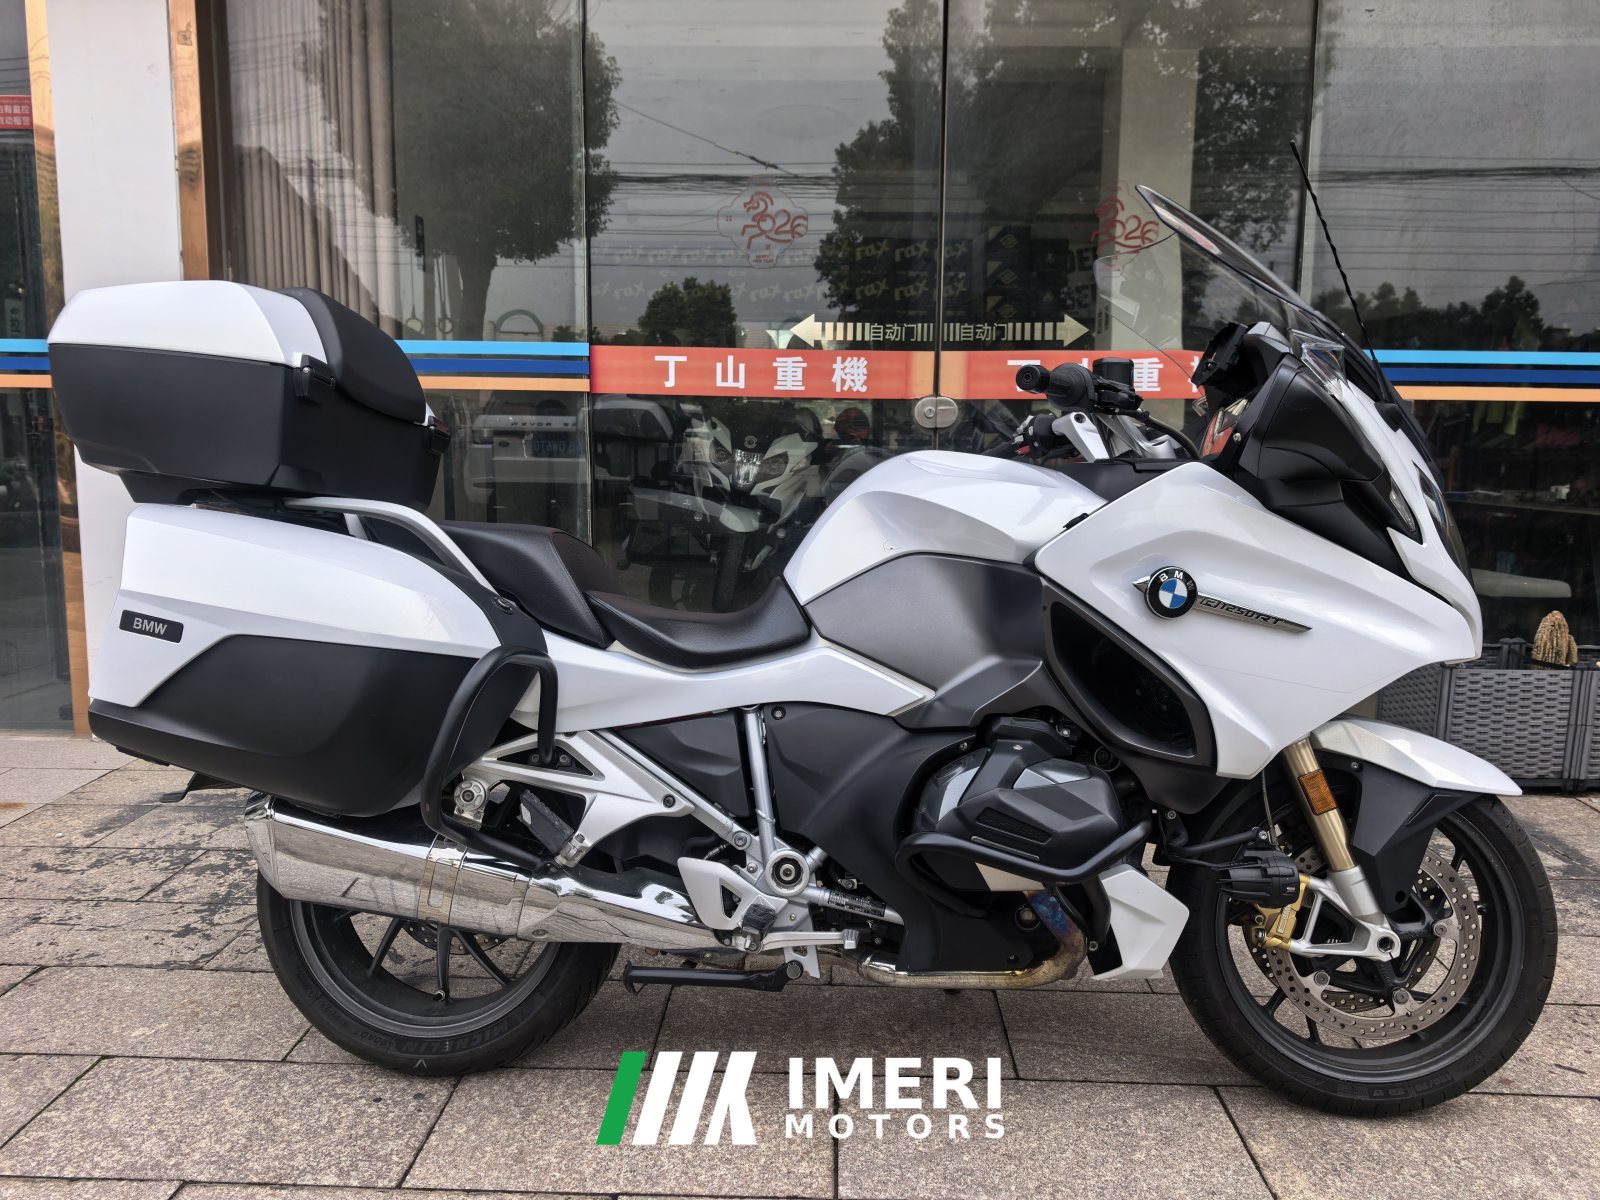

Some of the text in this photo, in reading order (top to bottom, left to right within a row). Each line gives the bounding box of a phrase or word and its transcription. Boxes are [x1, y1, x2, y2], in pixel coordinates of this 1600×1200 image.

[894, 240, 929, 263] rax
[894, 279, 928, 302] rax
[870, 323, 917, 342] 自动门
[960, 323, 1007, 342] 自动门
[654, 355, 869, 393] 丁山重機
[1159, 570, 1195, 591] BMW
[133, 617, 168, 635] BMW
